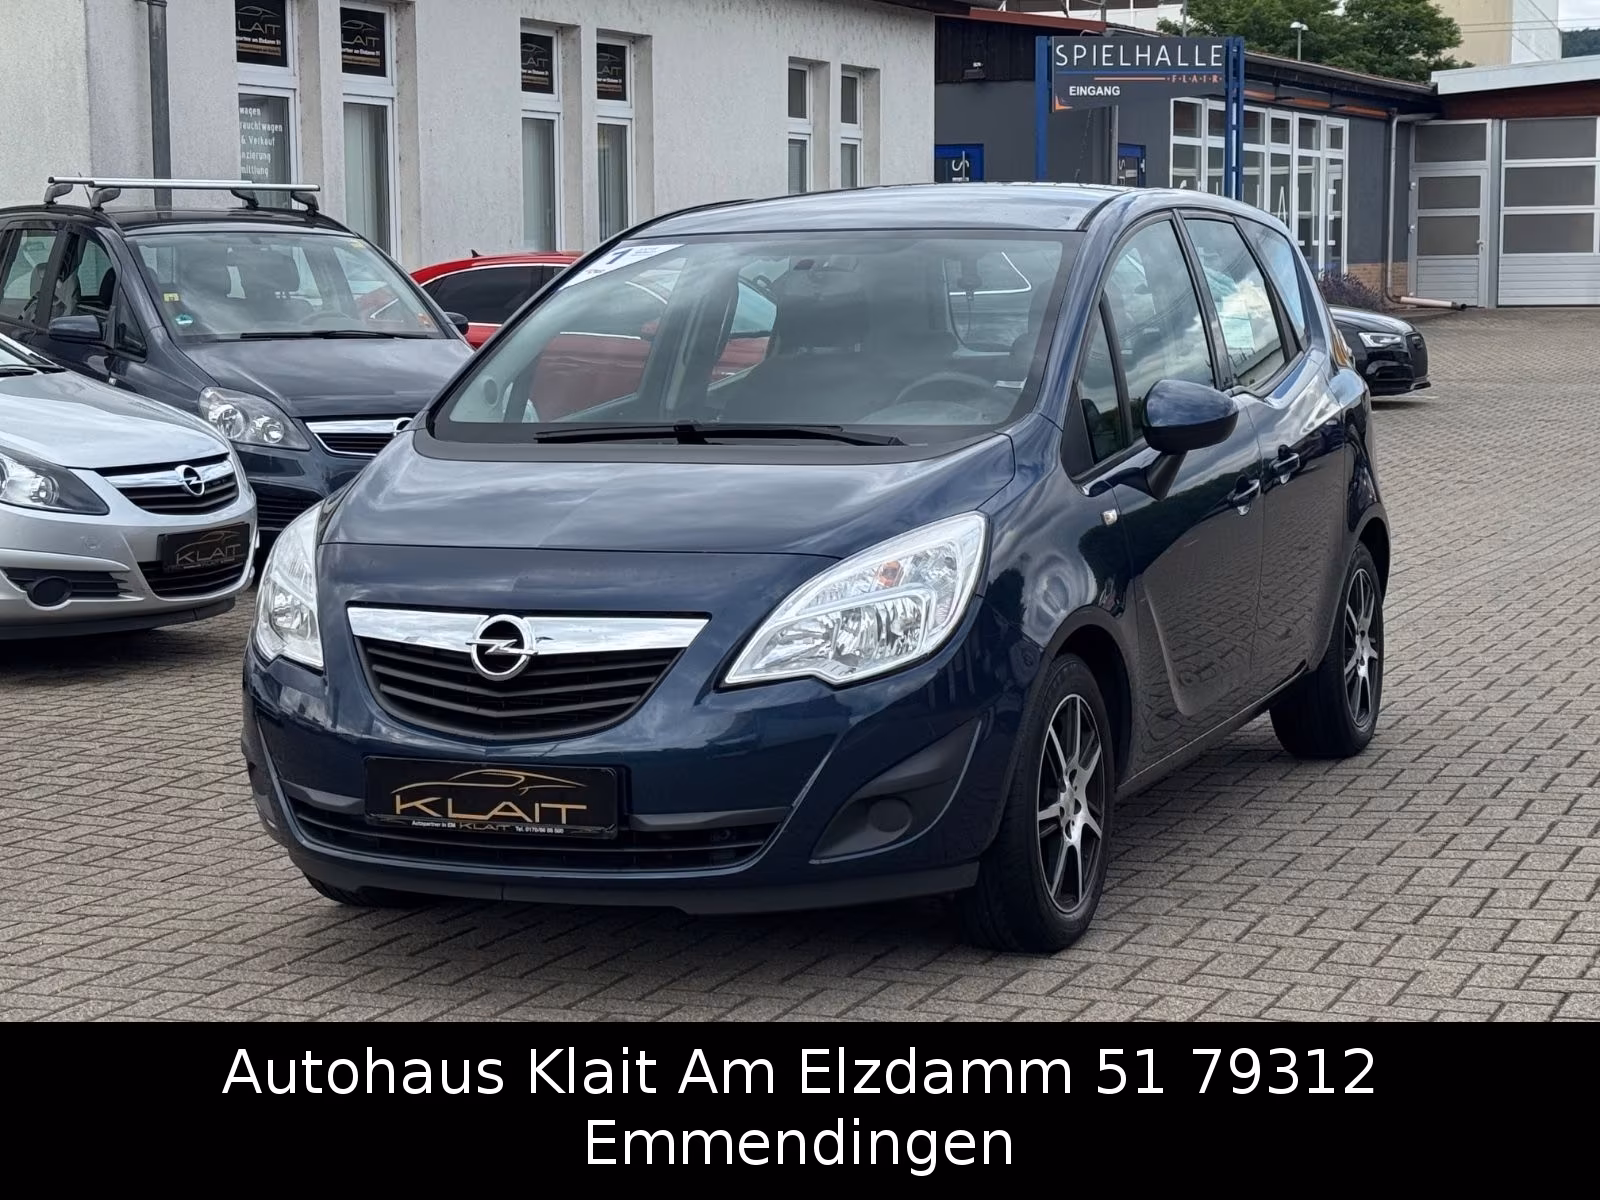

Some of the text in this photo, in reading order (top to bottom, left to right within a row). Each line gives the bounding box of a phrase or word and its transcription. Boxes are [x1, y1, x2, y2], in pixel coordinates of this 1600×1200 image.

[1056, 45, 1223, 66] SPIELHALLE
[1069, 86, 1121, 96] EINGANG
[240, 107, 261, 117] wagen
[176, 544, 241, 565] KLAIT
[396, 794, 587, 824] KLAIT
